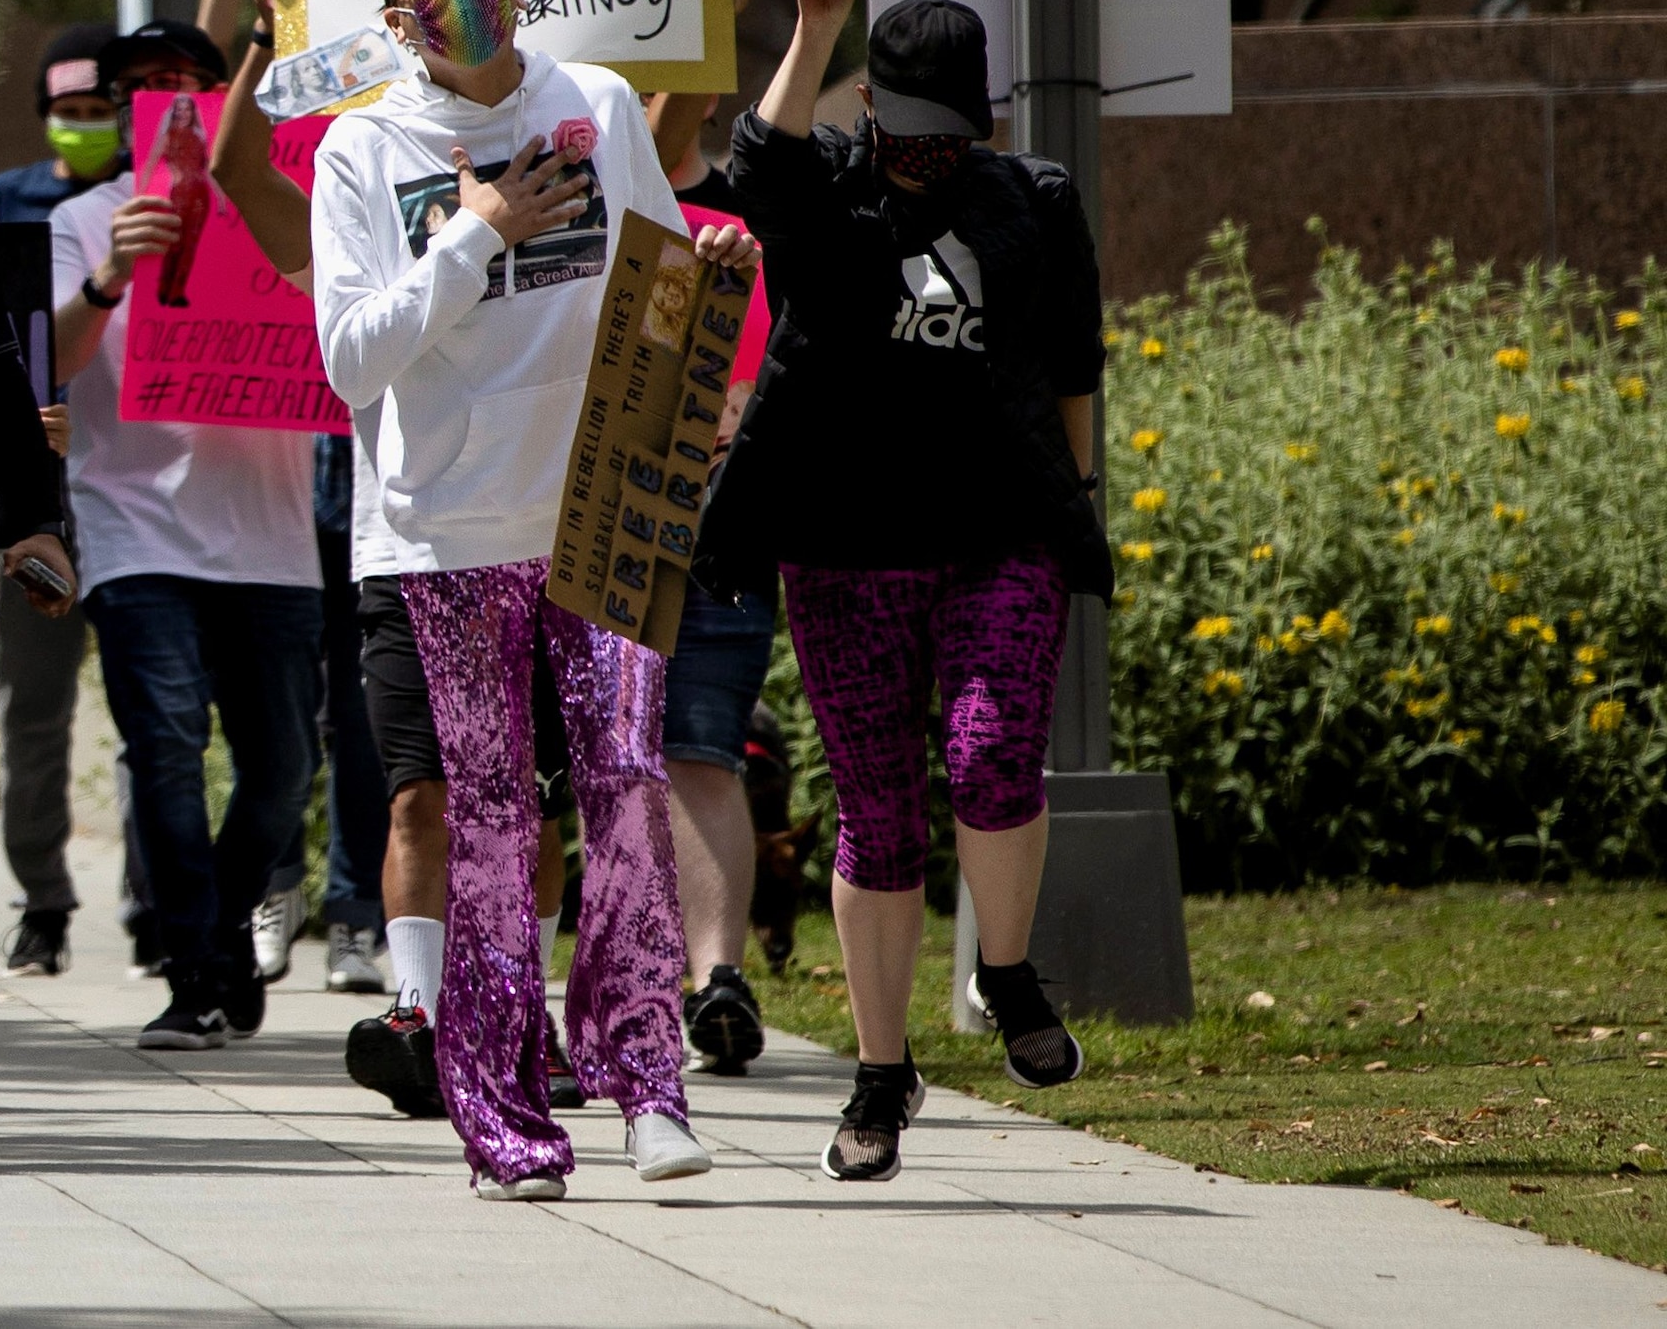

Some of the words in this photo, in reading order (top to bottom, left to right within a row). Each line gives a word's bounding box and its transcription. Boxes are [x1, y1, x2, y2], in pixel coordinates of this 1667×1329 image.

[533, 265, 576, 286] Great
[626, 256, 643, 273] A
[602, 288, 634, 366] THERE'S
[573, 396, 609, 502] REBELLION
[659, 264, 750, 556] BRITNEY
[585, 492, 620, 594] SPARKLE
[610, 443, 627, 478] OF
[622, 345, 653, 415] TRUTH
[568, 508, 583, 531] IN
[605, 455, 664, 627] FREE
[558, 539, 578, 584] BUT
